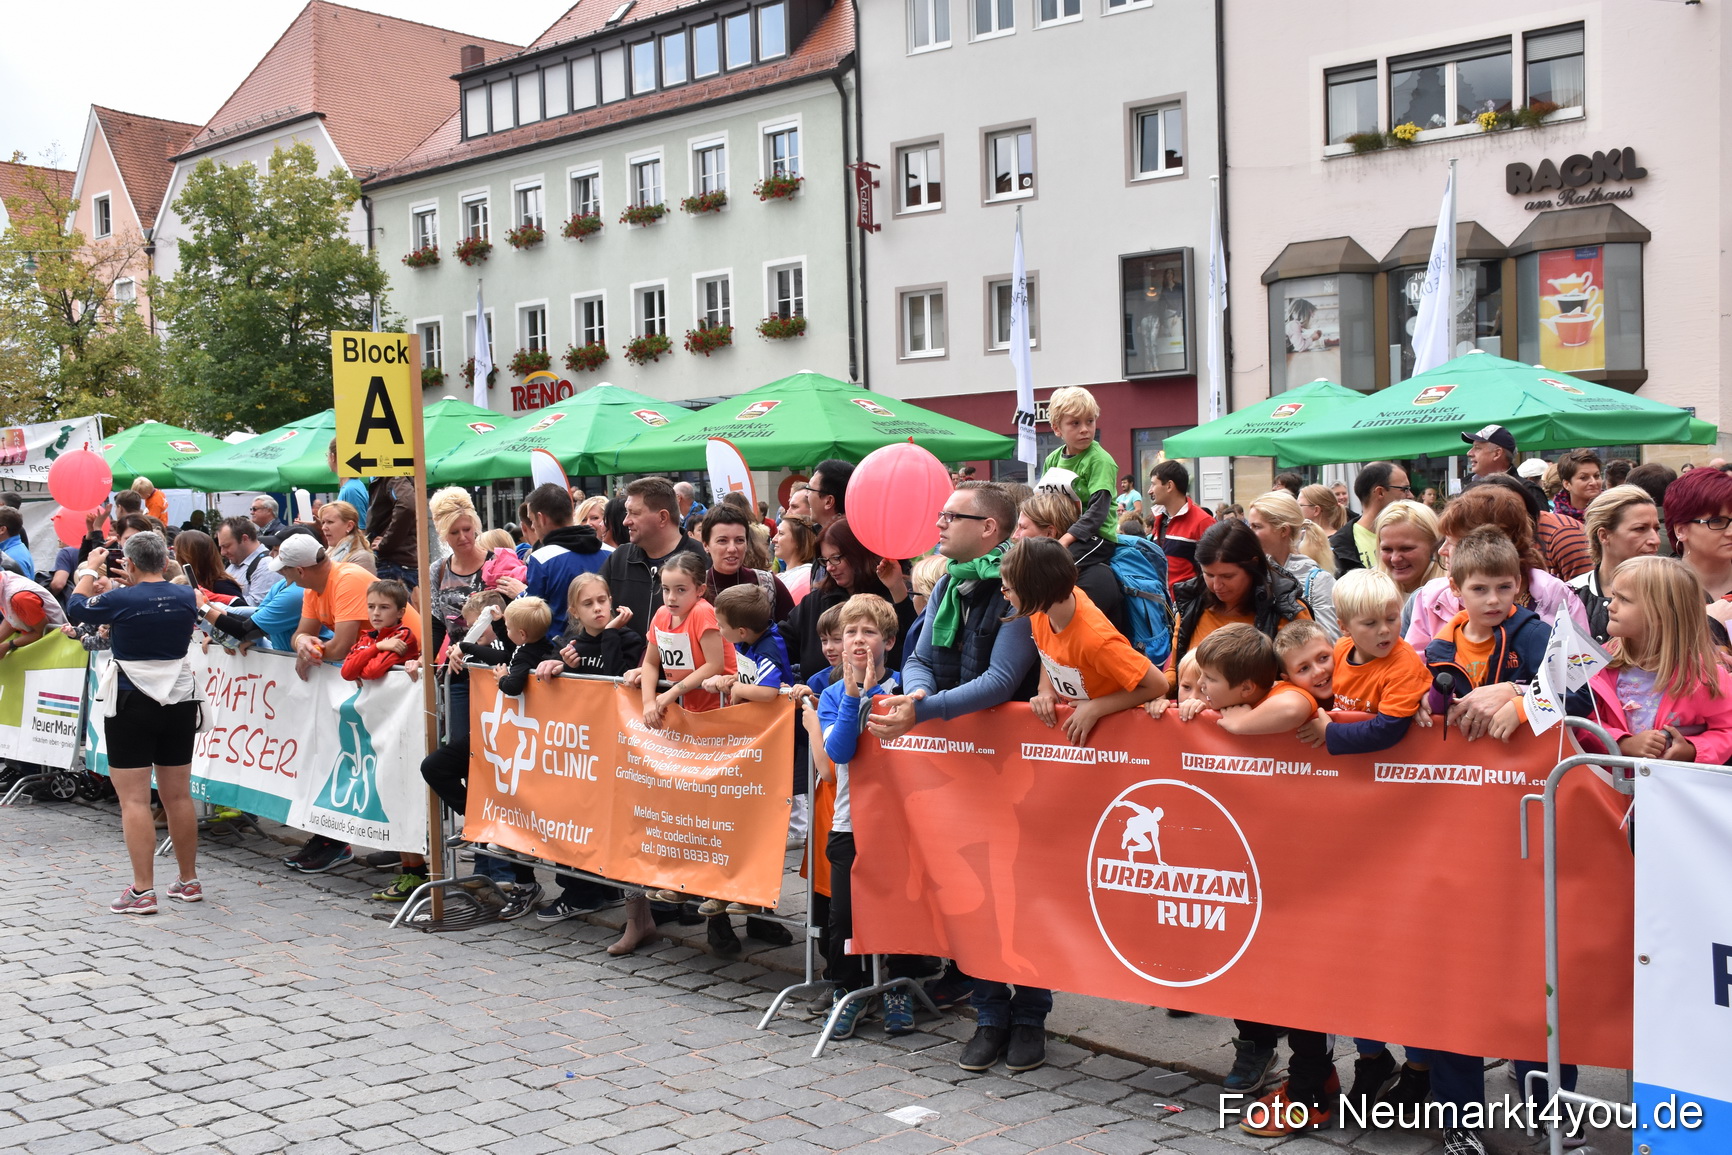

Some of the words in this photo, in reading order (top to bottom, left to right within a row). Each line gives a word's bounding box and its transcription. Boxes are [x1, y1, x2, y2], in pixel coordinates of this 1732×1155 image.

[1506, 146, 1648, 195] RACKL
[859, 177, 870, 224] Achatz
[1524, 199, 1553, 211] am
[1556, 186, 1634, 207] Rathaus
[343, 337, 410, 364] Block
[511, 379, 574, 411] RENO
[355, 376, 405, 444] A
[1352, 412, 1466, 428] Lammsbräu
[1376, 406, 1460, 418] Neumarkter
[673, 428, 776, 442] Lammsbräu
[699, 422, 774, 433] Neumarkter
[1225, 426, 1294, 435] Lammsbr
[1243, 420, 1306, 428] Neumarkter
[29, 464, 52, 473] Res
[660, 647, 685, 666] 002
[204, 667, 276, 720] ÄUFTS
[32, 716, 77, 737] NeuerMark
[544, 720, 590, 750] CODE
[617, 731, 627, 745] für
[627, 734, 641, 746] die
[641, 738, 696, 760] Konzeption
[695, 751, 713, 761] und
[1022, 745, 1095, 763] URBANIAN
[542, 749, 599, 781] CLINIC
[627, 751, 641, 766] Ihrer
[642, 755, 681, 774] Projekte
[680, 763, 699, 773] was
[1183, 754, 1273, 774] URBANIAN
[657, 776, 672, 788] und
[674, 779, 718, 798] Werbung
[719, 782, 767, 799] angeht.
[1376, 764, 1481, 783] URBANIAN
[1485, 769, 1549, 787] RUN.co
[309, 811, 320, 825] Jura
[320, 814, 345, 832] Gebäude
[367, 829, 390, 842] GmbH
[482, 798, 593, 845] KreativAgentur
[634, 805, 660, 821] Melden
[661, 811, 674, 824] Sie
[675, 814, 694, 828] sich
[695, 815, 710, 829] bei
[712, 819, 735, 832] uns:
[645, 826, 662, 838] web:
[663, 830, 722, 848] codeclinic.de
[641, 841, 656, 854] tel:
[656, 844, 681, 859] 09181
[684, 849, 710, 863] 8833
[712, 853, 730, 866] 897
[1099, 861, 1246, 900] URBANIAN
[1157, 900, 1226, 931] RUN
